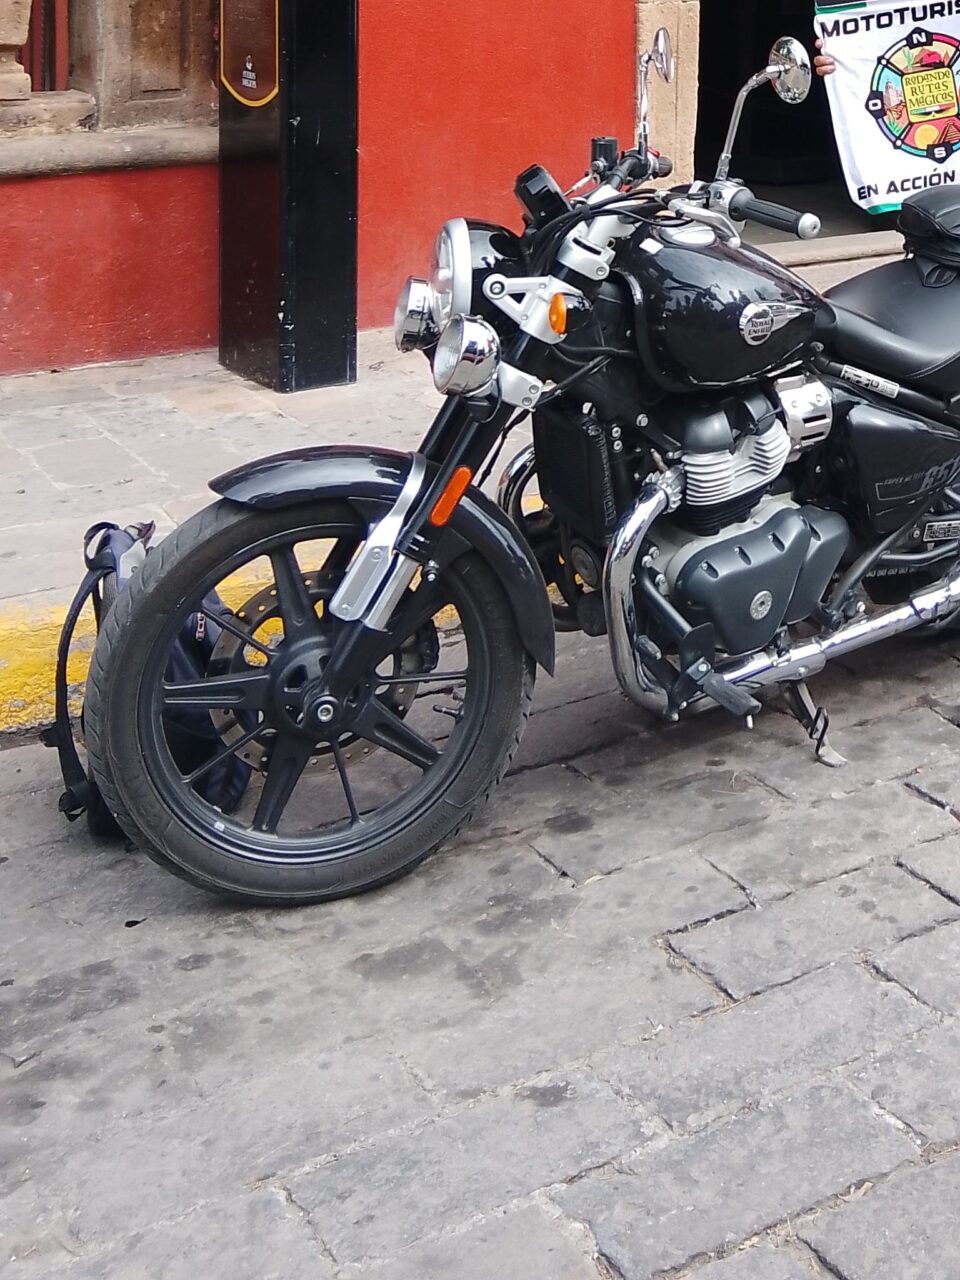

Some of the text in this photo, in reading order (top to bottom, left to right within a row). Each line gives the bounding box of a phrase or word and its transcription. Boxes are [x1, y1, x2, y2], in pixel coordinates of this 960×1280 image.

[912, 32, 927, 44] N
[868, 99, 882, 110] O
[934, 147, 947, 158] S
[858, 184, 879, 200] EN
[886, 168, 956, 196] ACCIÓN
[752, 319, 770, 328] ROYAL
[748, 326, 772, 336] ENFIELD
